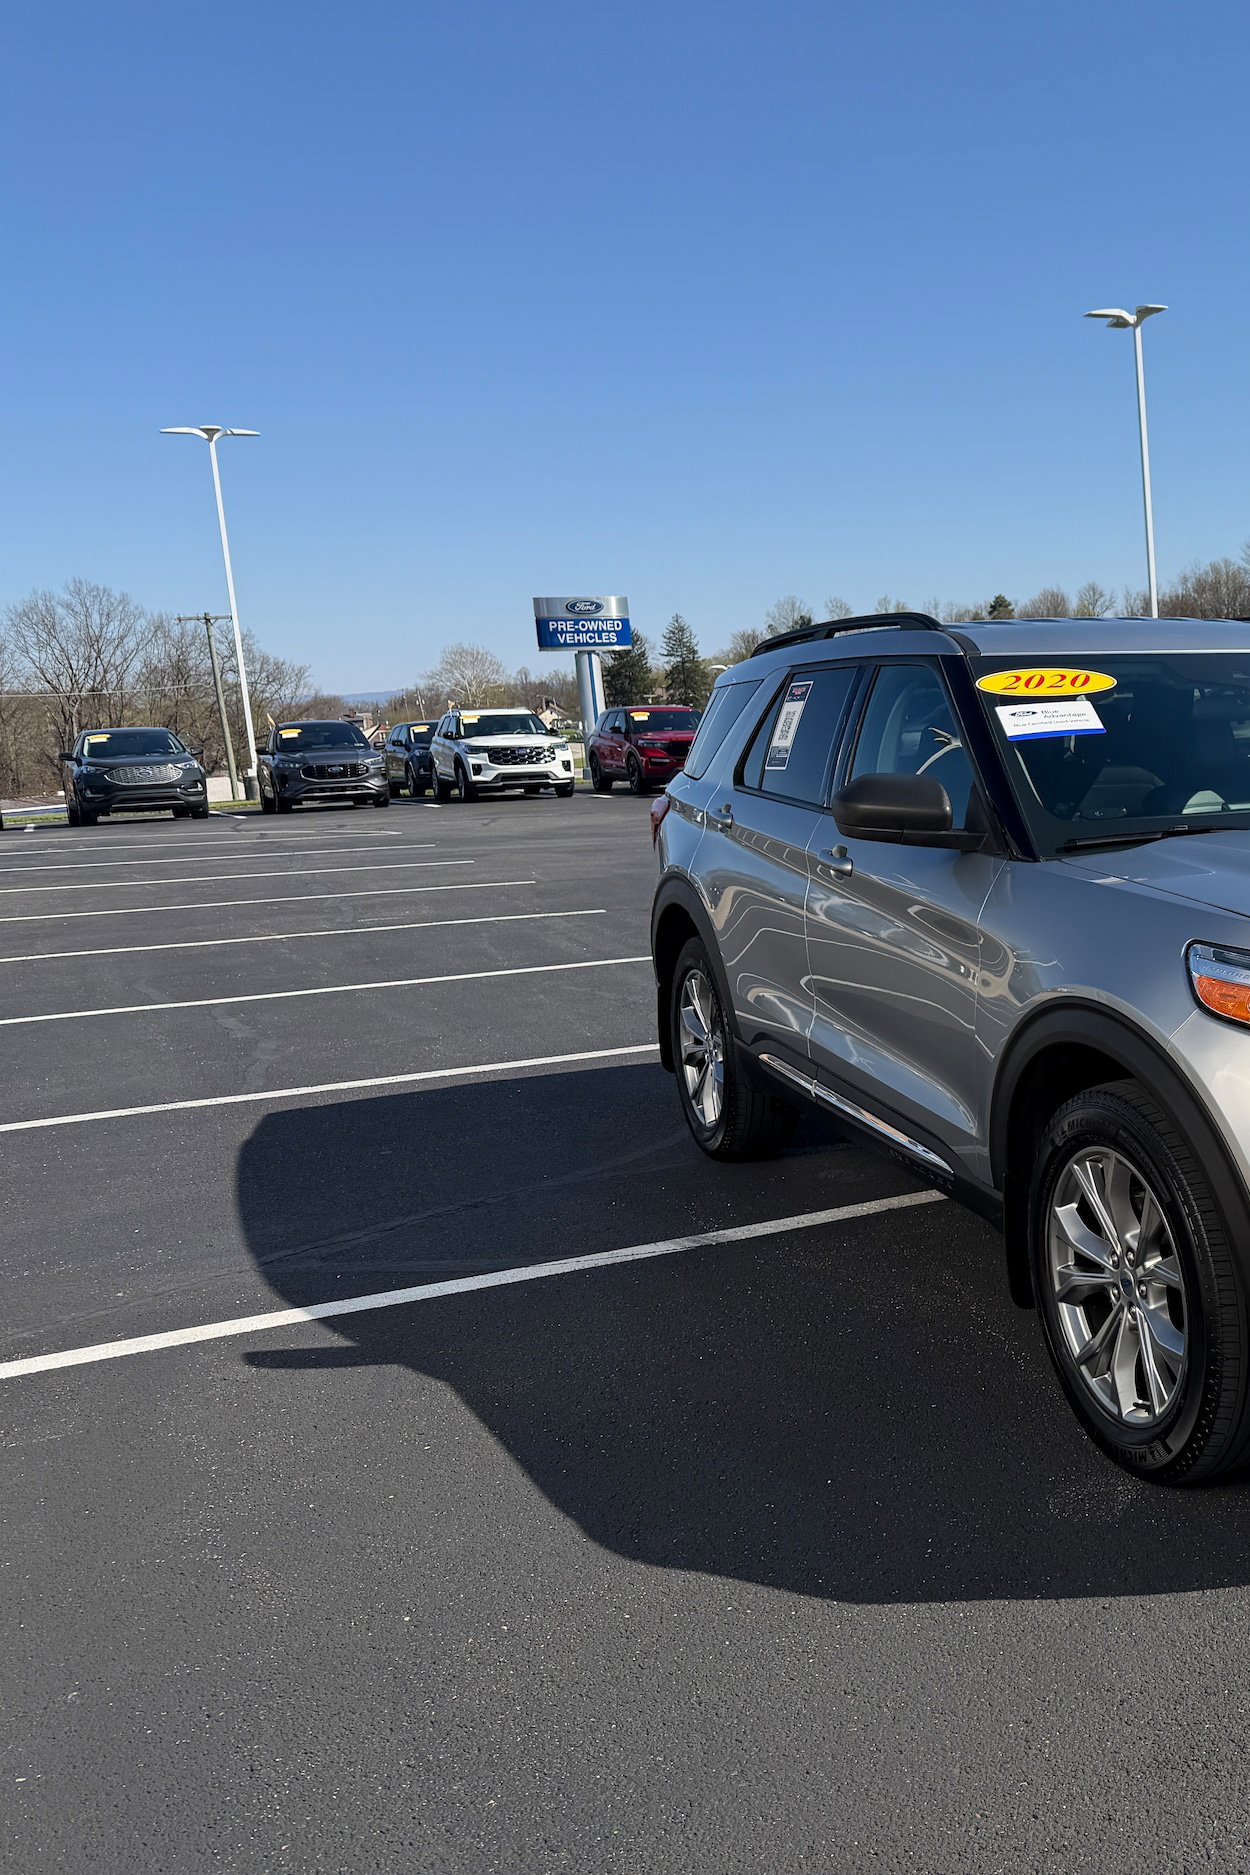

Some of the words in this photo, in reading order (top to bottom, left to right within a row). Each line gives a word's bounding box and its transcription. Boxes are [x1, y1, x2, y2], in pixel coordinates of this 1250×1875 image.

[574, 601, 596, 611] Ford
[549, 620, 622, 632] PRE-OWNED
[557, 632, 618, 644] VEHICLES
[1001, 672, 1091, 691] 2020
